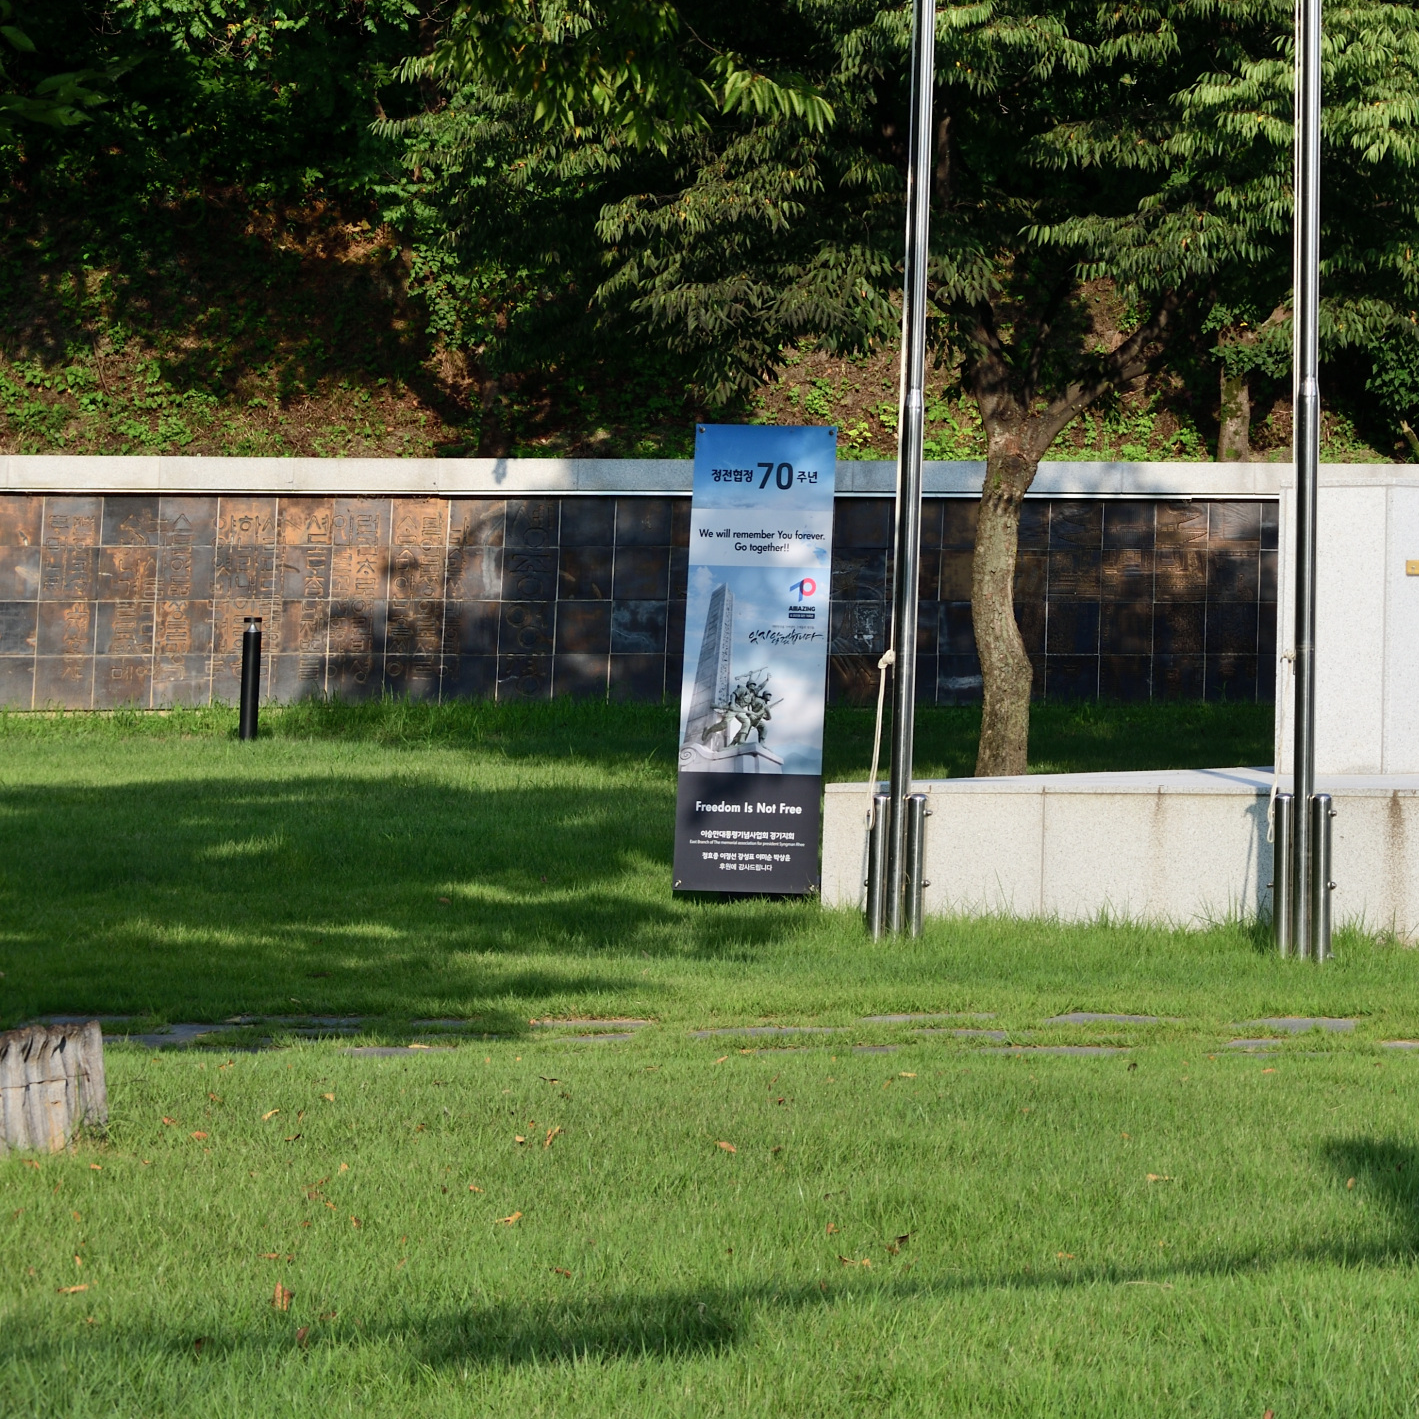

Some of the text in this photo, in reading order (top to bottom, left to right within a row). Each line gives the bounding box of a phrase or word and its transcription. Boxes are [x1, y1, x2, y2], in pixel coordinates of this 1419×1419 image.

[711, 462, 818, 490] 정전협정 70 주년
[699, 528, 826, 541] We will remember You forever.
[734, 542, 790, 554] Go together!!
[696, 800, 802, 815] Freedom Is Not Free
